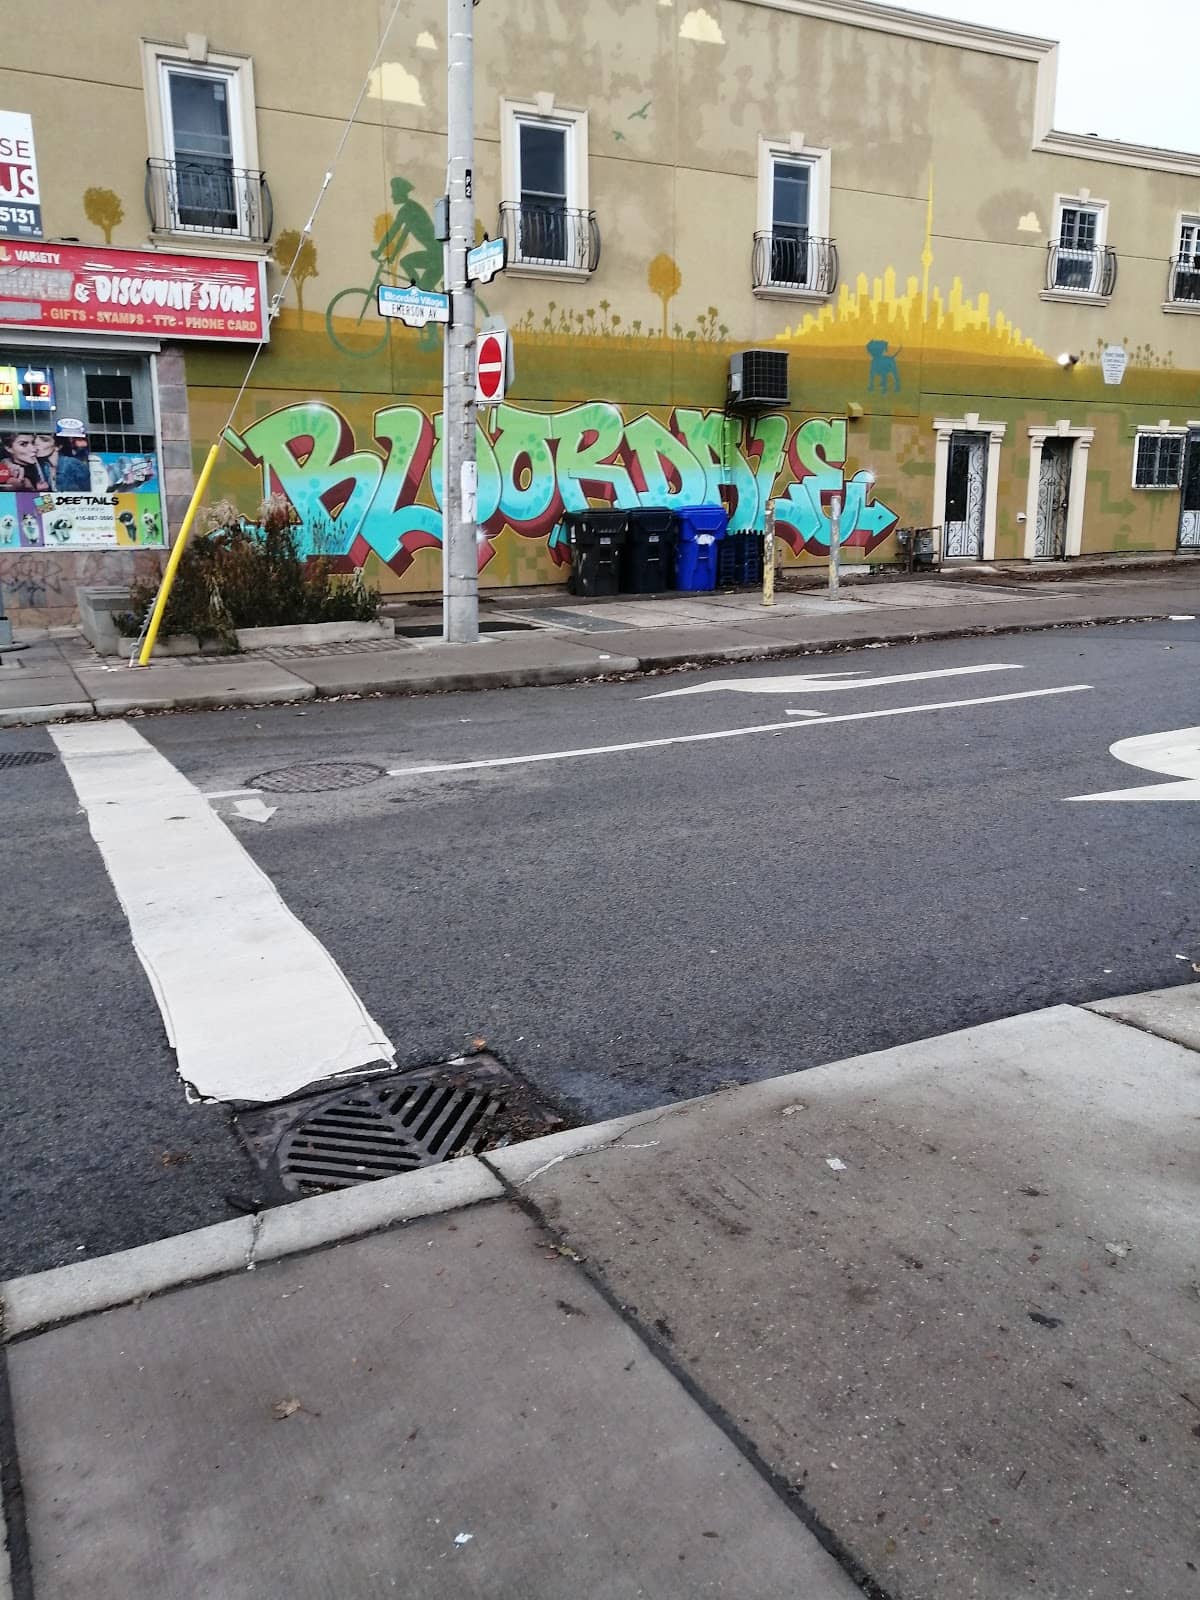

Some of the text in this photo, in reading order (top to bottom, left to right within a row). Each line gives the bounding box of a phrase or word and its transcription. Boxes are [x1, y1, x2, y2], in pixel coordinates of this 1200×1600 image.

[15, 250, 60, 265] VARIETY
[75, 283, 91, 303] &
[95, 275, 195, 311] DISCOUNT
[198, 282, 257, 313] STORE
[391, 303, 424, 318] EMERSON
[50, 308, 258, 332] GIFTS STAMPS TTC PHONE CARD
[55, 496, 119, 506] DEE'TAILS
